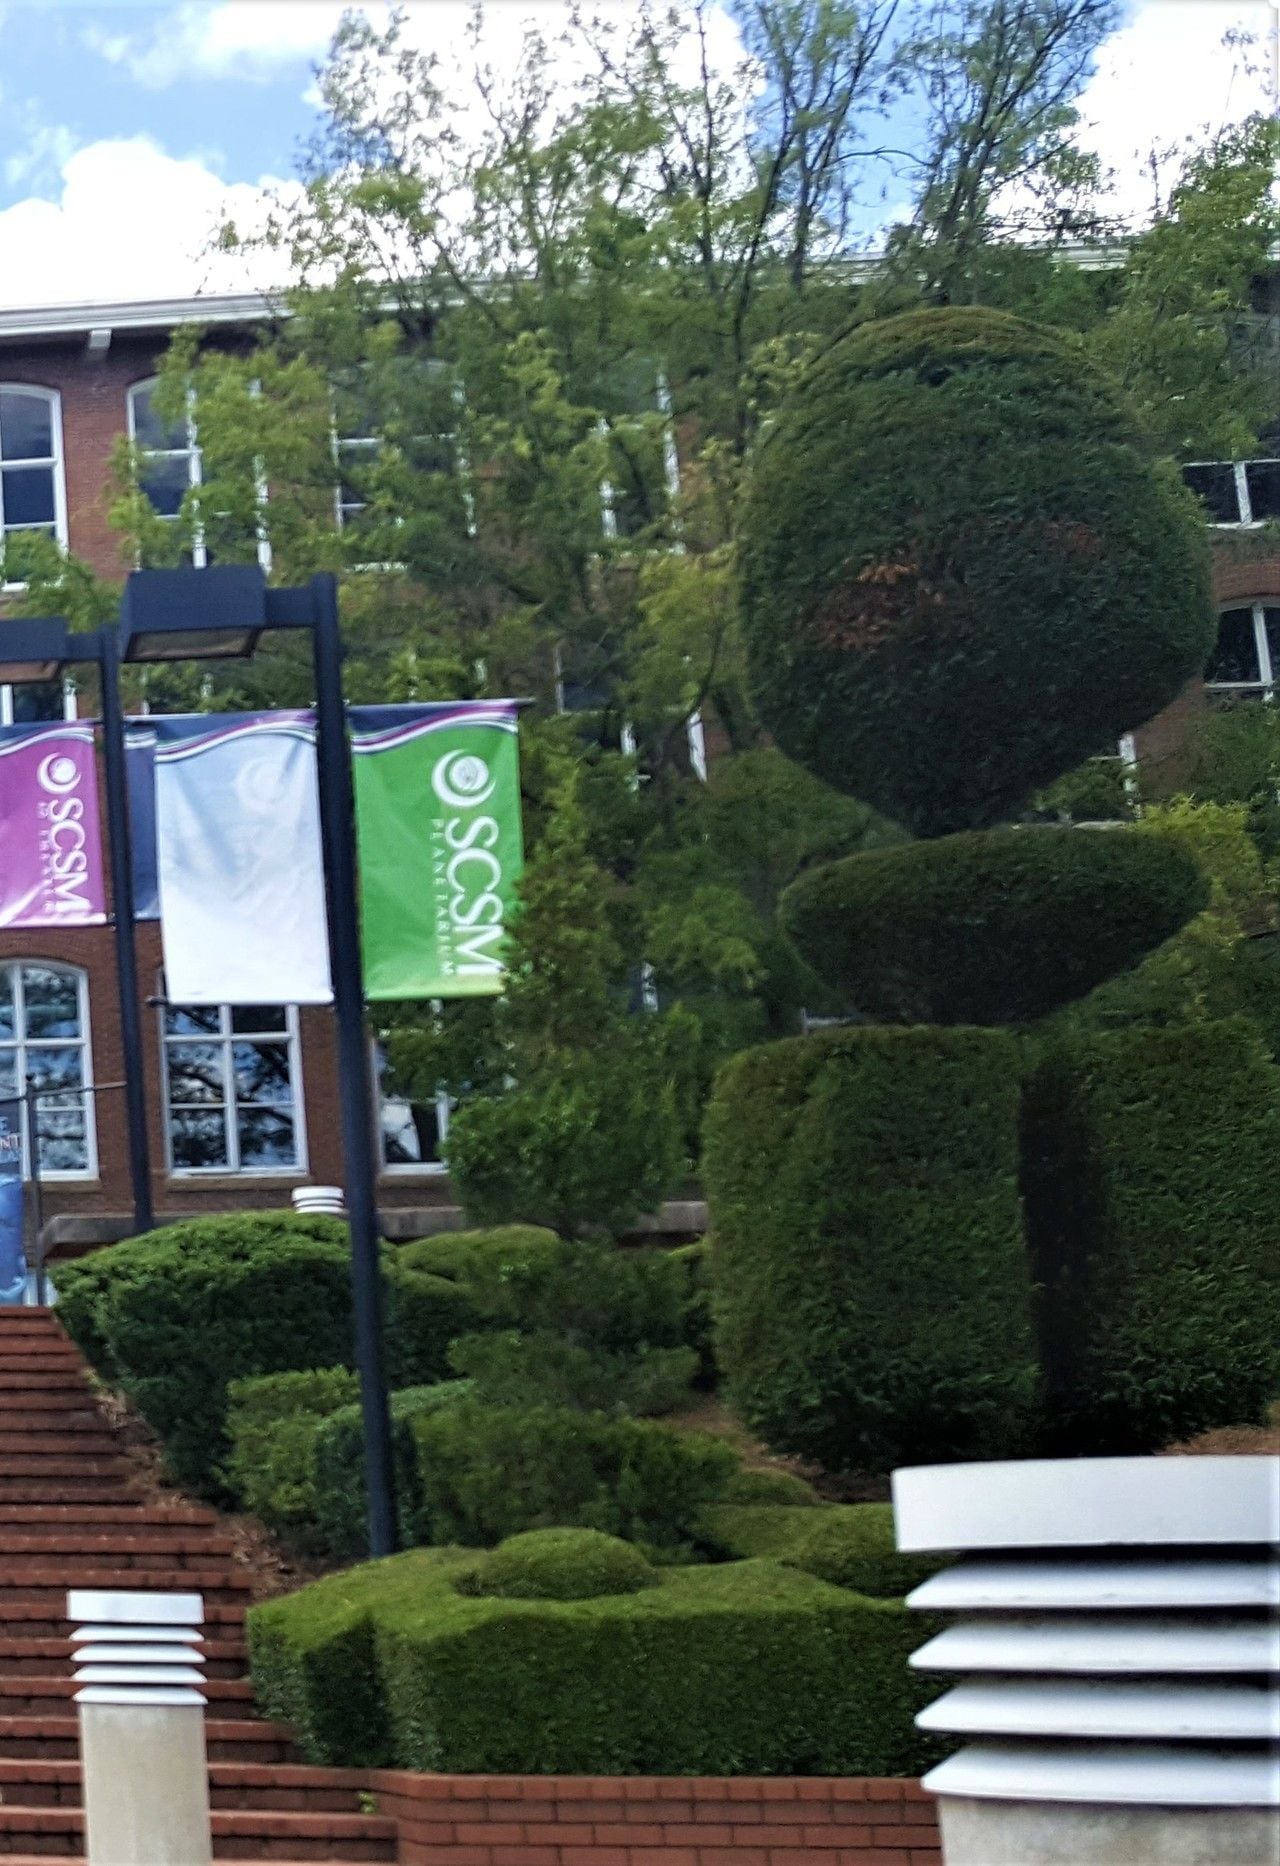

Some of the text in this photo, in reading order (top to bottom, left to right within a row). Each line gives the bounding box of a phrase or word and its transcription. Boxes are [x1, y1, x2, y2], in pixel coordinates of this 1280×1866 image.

[48, 797, 91, 914] SCSM
[430, 818, 455, 976] PLANETARIUM
[445, 815, 505, 976] SCSM
